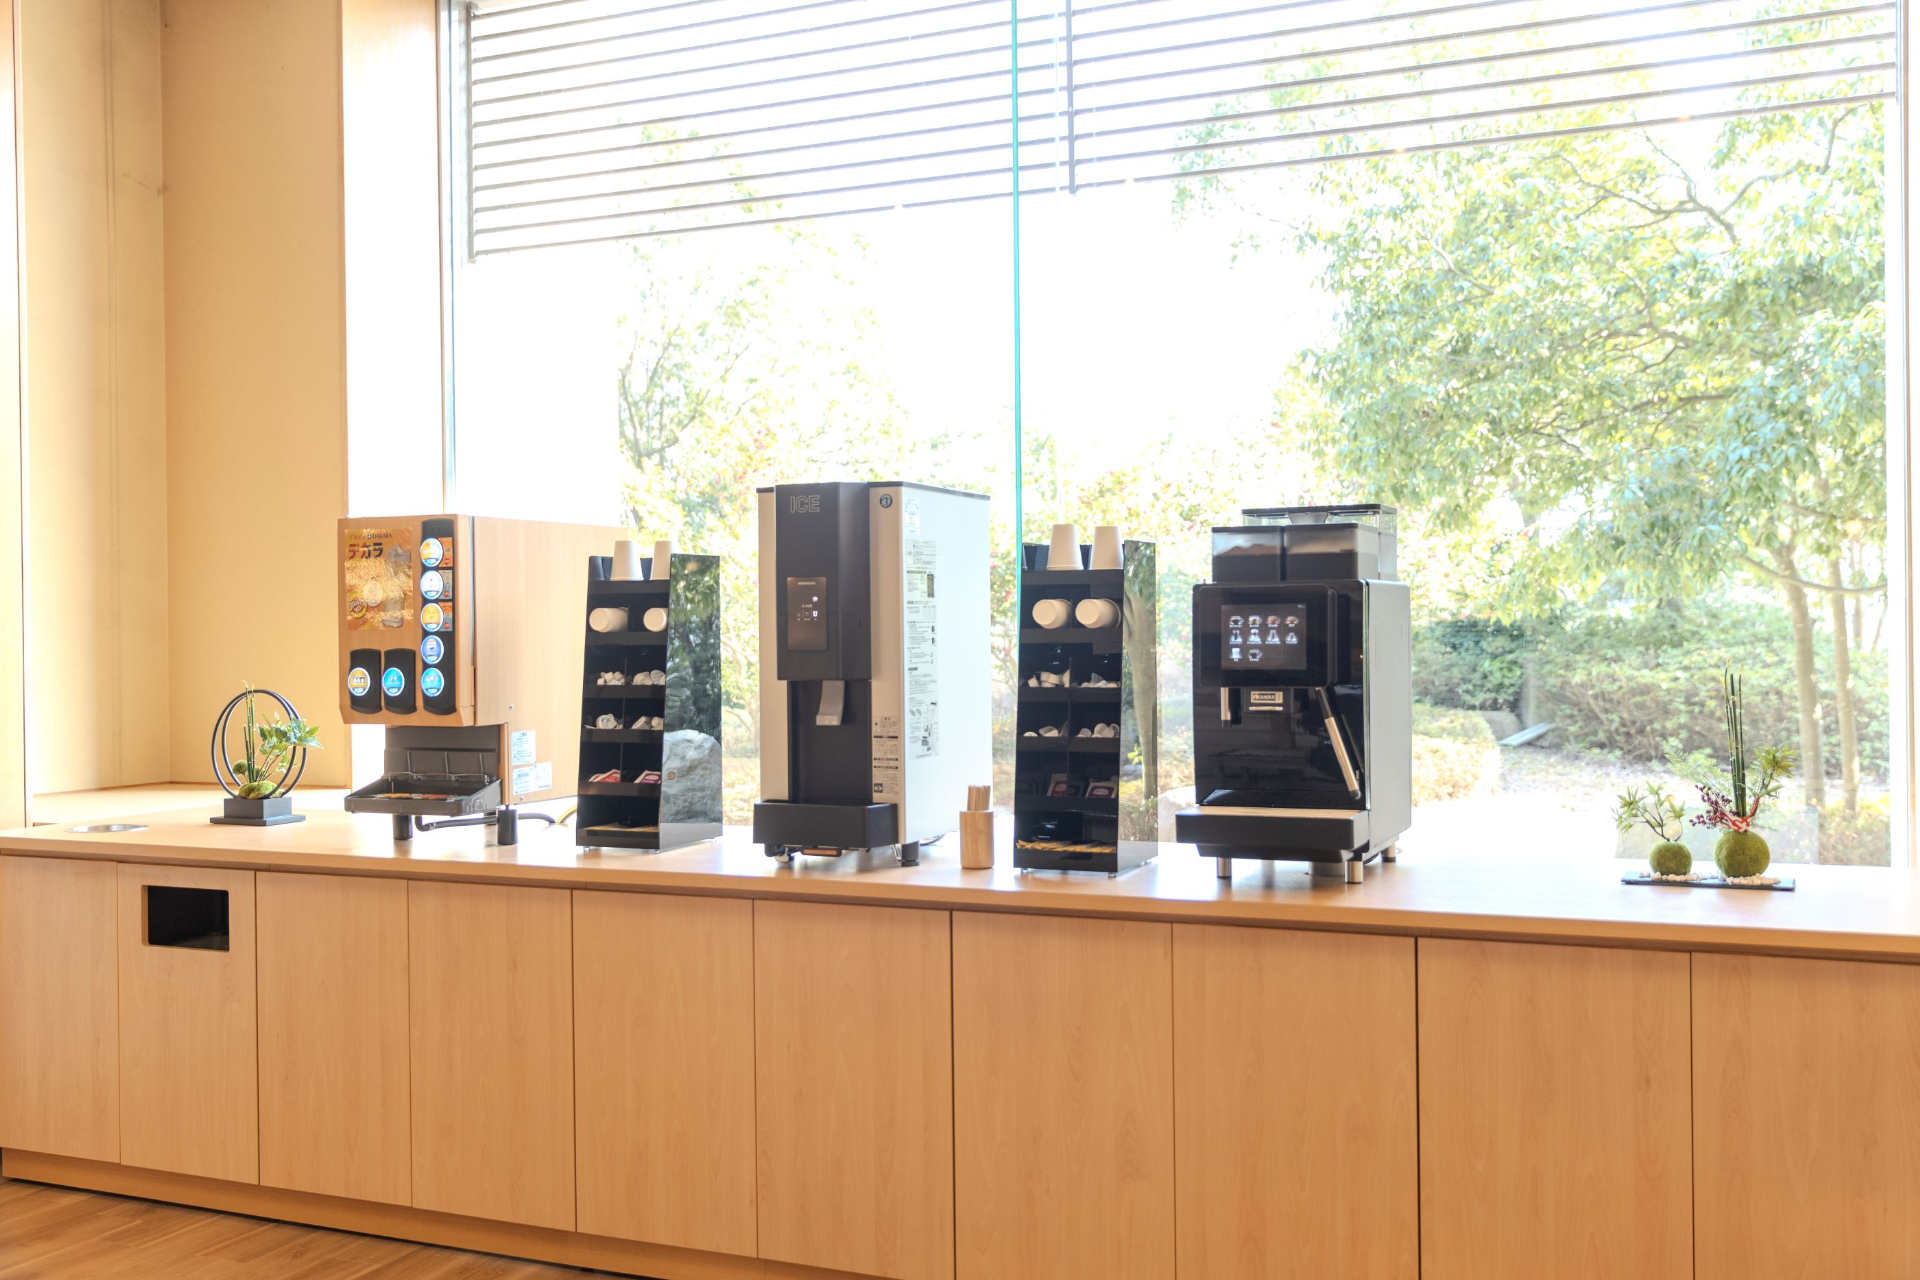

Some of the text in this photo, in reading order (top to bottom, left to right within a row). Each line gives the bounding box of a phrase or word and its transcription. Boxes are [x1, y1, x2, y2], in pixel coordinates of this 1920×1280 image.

[790, 495, 820, 513] ICE
[348, 542, 384, 560] デカラ
